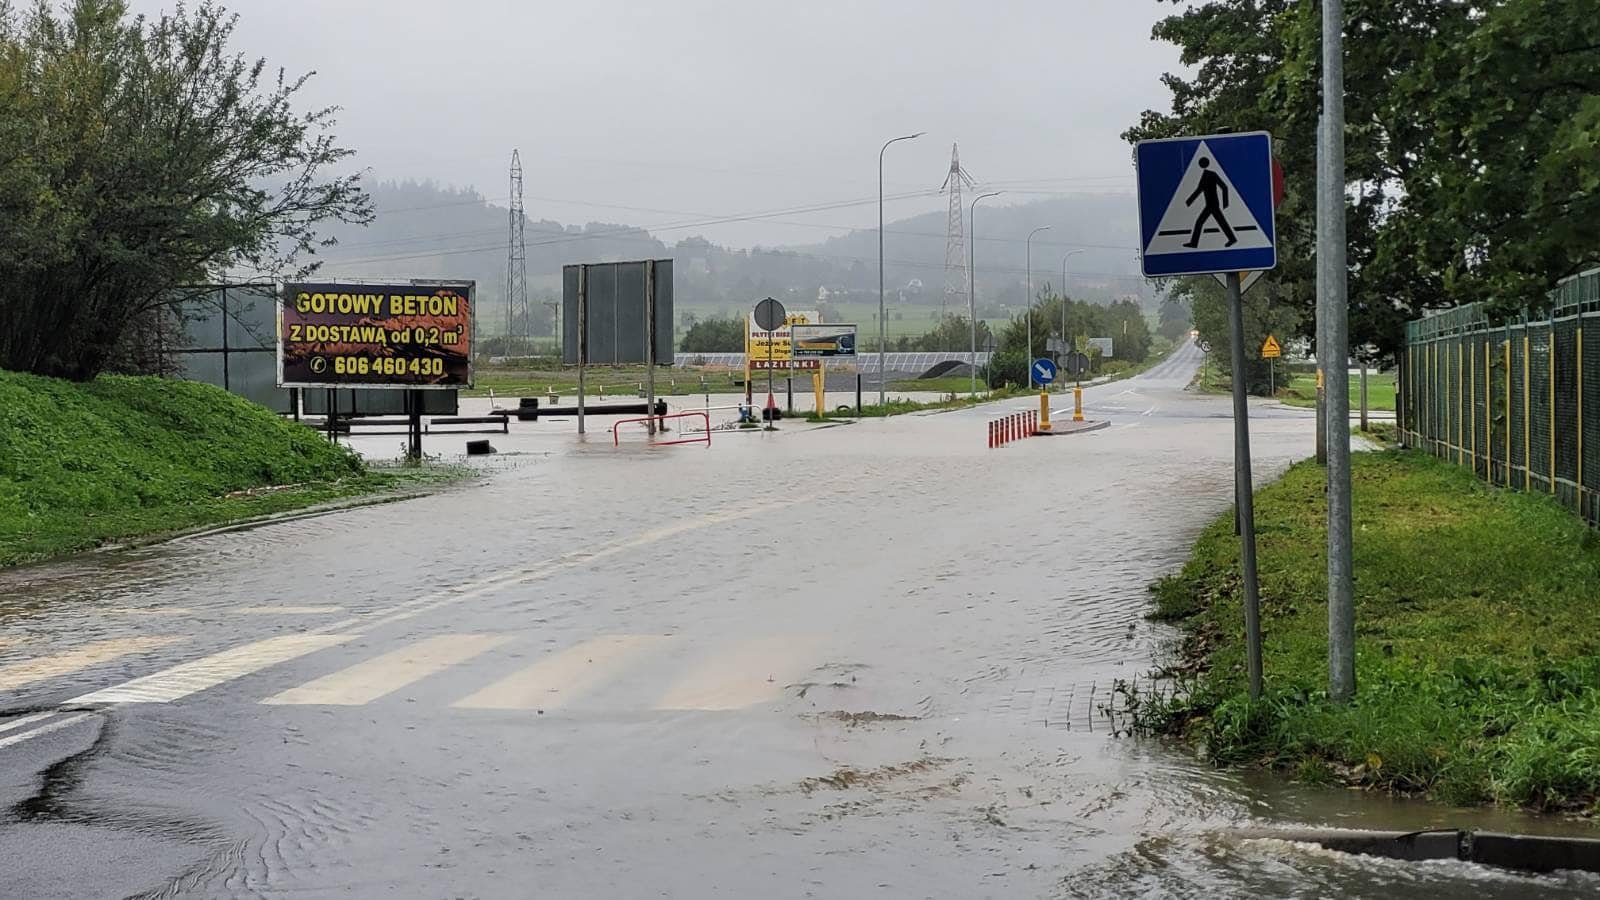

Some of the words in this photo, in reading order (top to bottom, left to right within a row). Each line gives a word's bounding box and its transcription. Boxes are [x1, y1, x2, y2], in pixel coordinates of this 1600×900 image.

[296, 293, 384, 315] GOTOWY
[390, 295, 457, 315] BETON
[290, 326, 302, 341] Z
[307, 326, 387, 346] DOSTAWĄ
[391, 328, 410, 343] od
[415, 328, 439, 346] 0,2
[335, 357, 369, 374] 606
[372, 357, 406, 375] 460
[409, 358, 443, 375] 430
